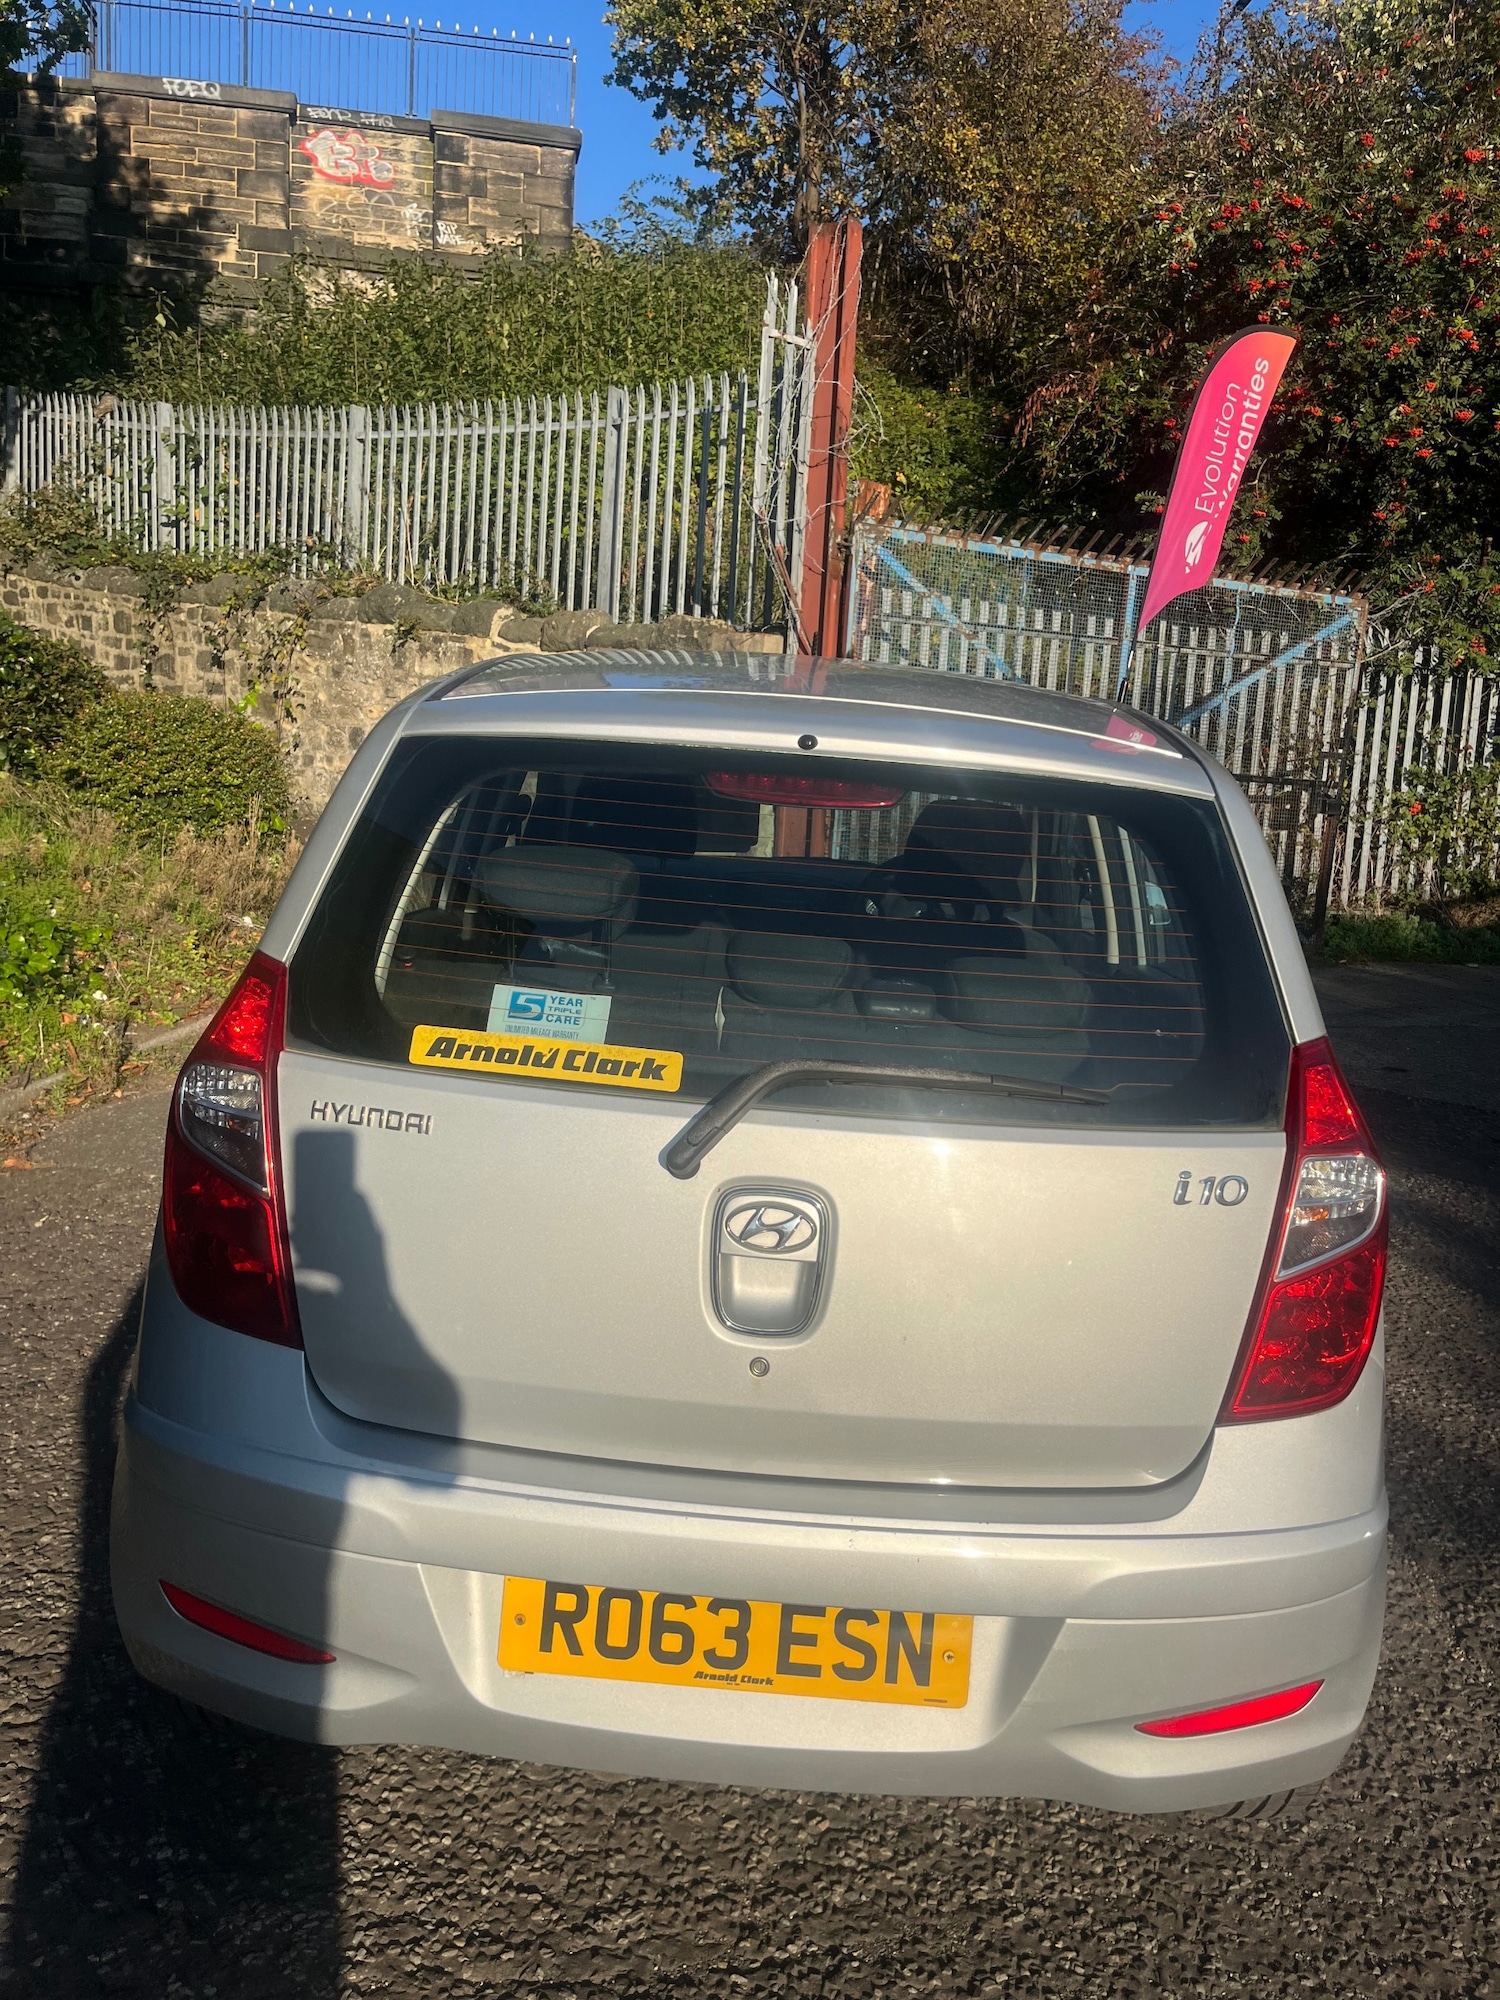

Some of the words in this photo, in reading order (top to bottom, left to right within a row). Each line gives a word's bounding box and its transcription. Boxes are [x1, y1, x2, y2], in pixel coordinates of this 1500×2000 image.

[437, 221, 458, 235] RIP
[1195, 383, 1240, 514] Evolution
[550, 995, 583, 1007] YEAR
[548, 1006, 582, 1015] TRIPLE
[545, 1014, 581, 1026] CARE
[504, 1024, 530, 1035] UNLIMITED
[530, 1026, 552, 1038] MILEAGE
[551, 1028, 579, 1040] WARRANTY
[425, 1036, 559, 1069] Arnold
[561, 1050, 668, 1081] Clark
[310, 1099, 434, 1135] HYUNDAI
[539, 1580, 752, 1671] RO63
[775, 1603, 935, 1687] ESN
[693, 1671, 739, 1682] Arnold
[740, 1675, 774, 1686] Clark
